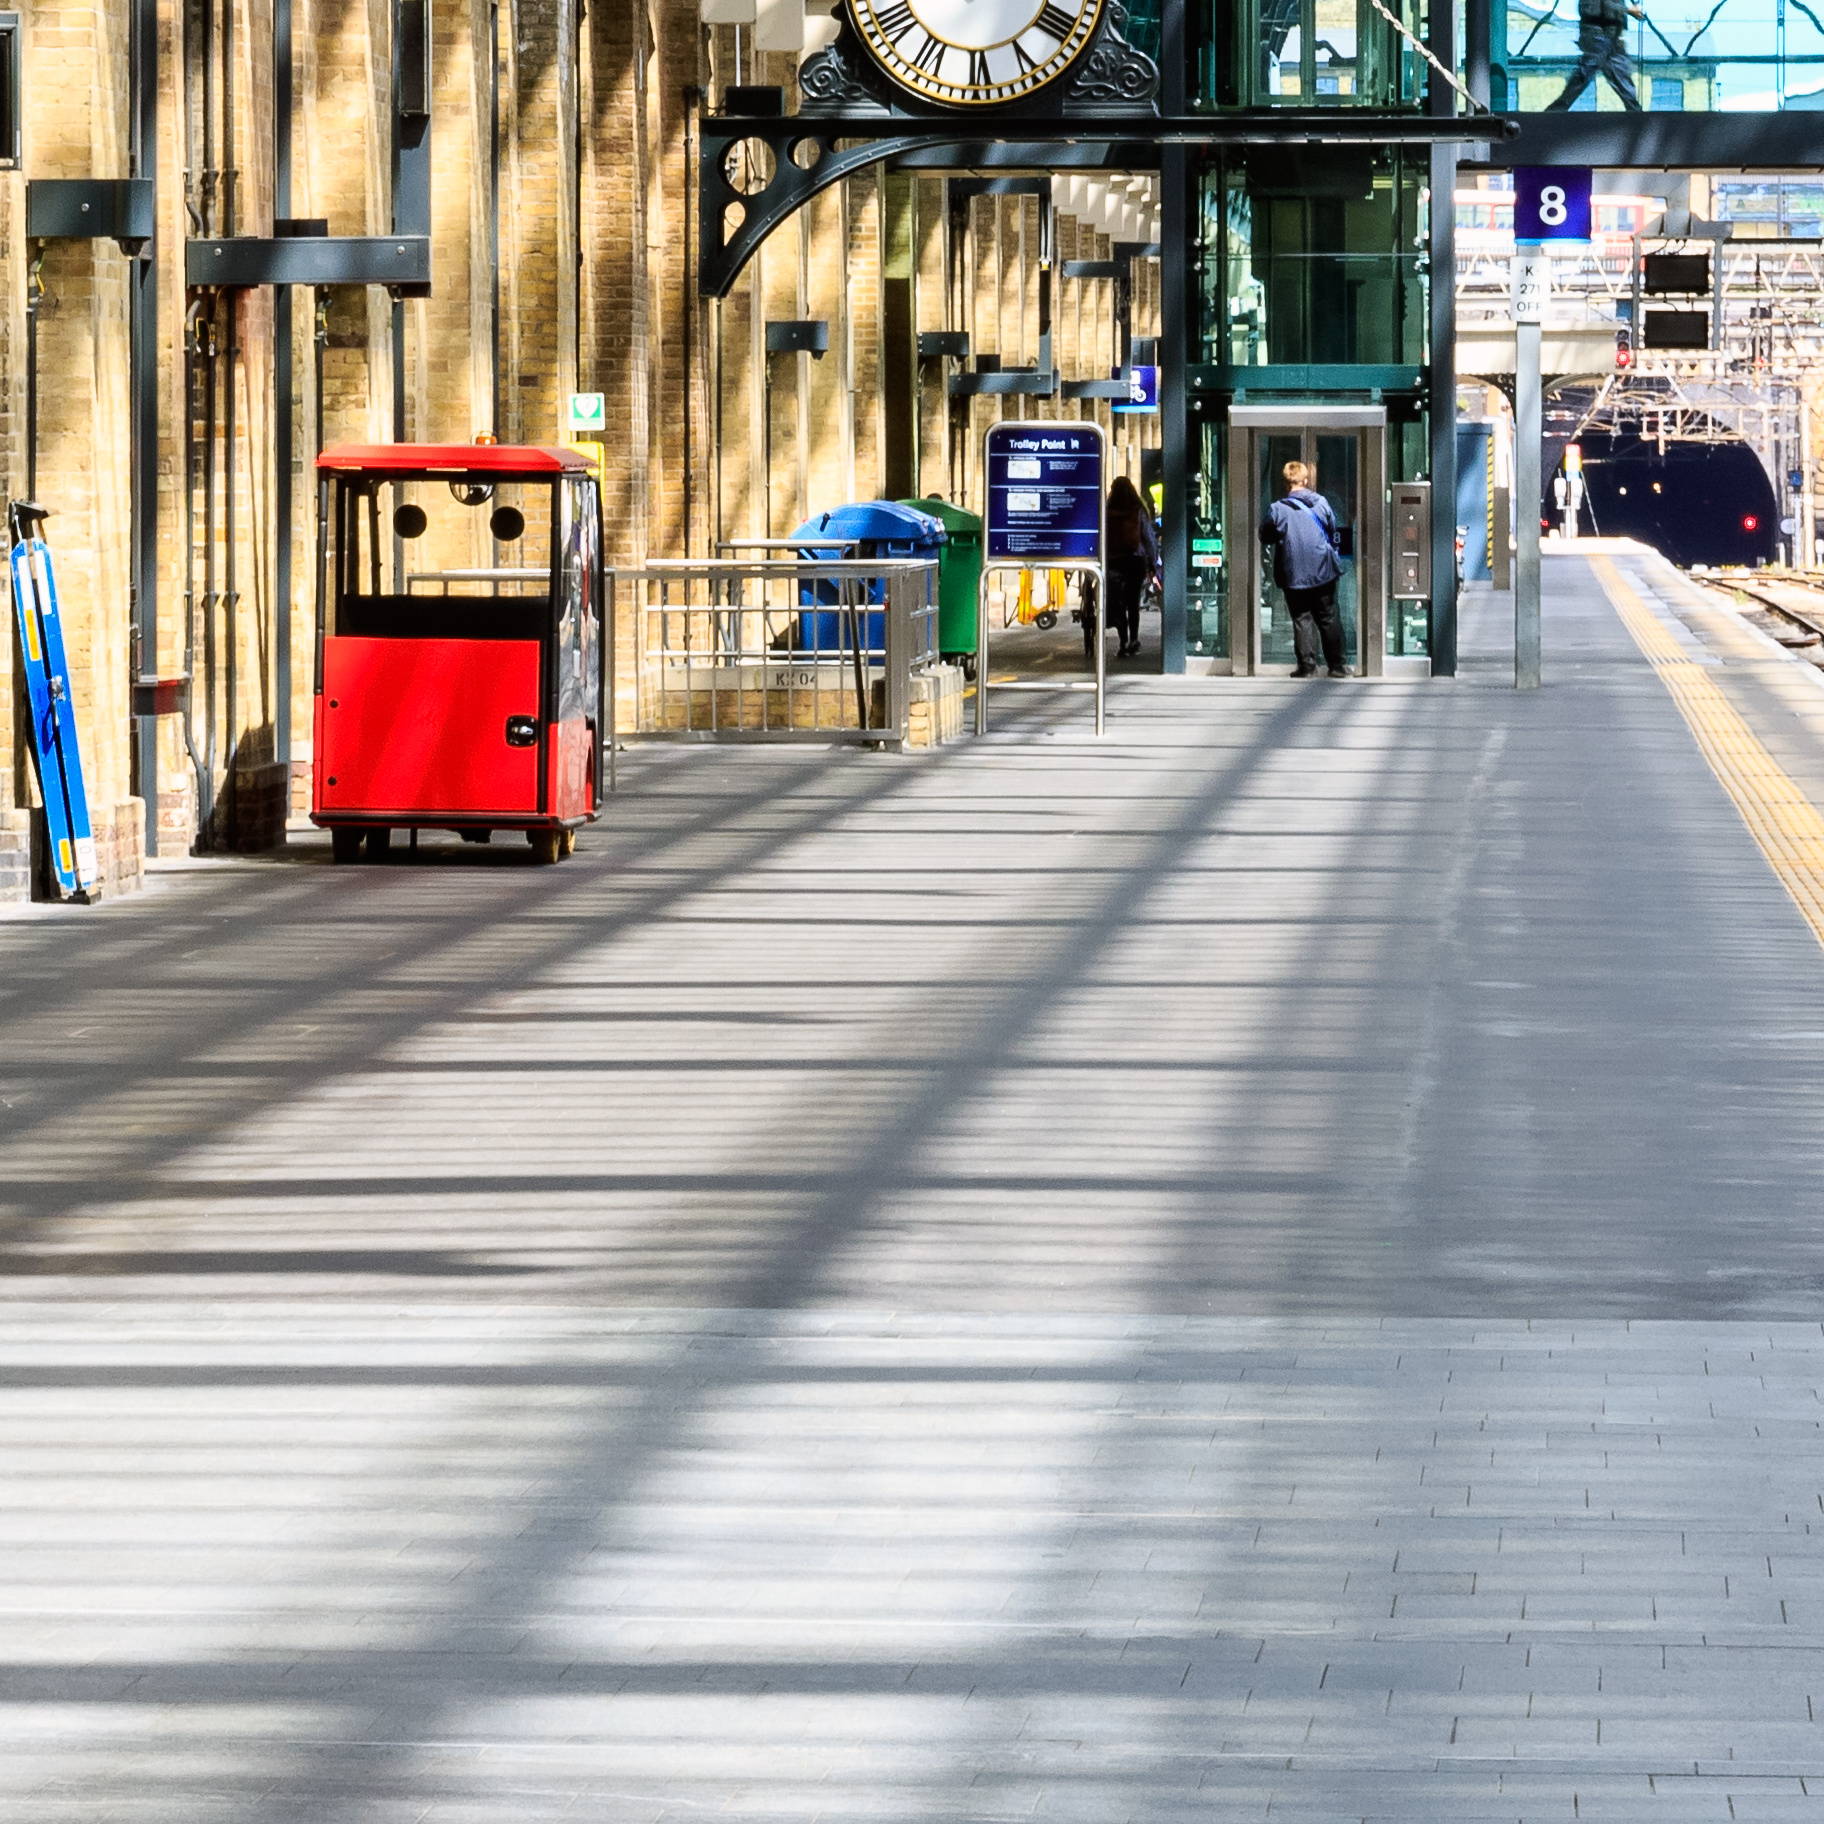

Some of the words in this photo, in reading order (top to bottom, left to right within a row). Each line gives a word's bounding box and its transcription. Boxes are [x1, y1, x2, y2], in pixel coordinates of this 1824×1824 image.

[1539, 185, 1567, 226] 8
[1525, 265, 1534, 276] K
[1520, 283, 1540, 294] 271
[1517, 302, 1543, 312] OFF
[1009, 439, 1040, 451] Trolley
[1041, 439, 1066, 449] Point
